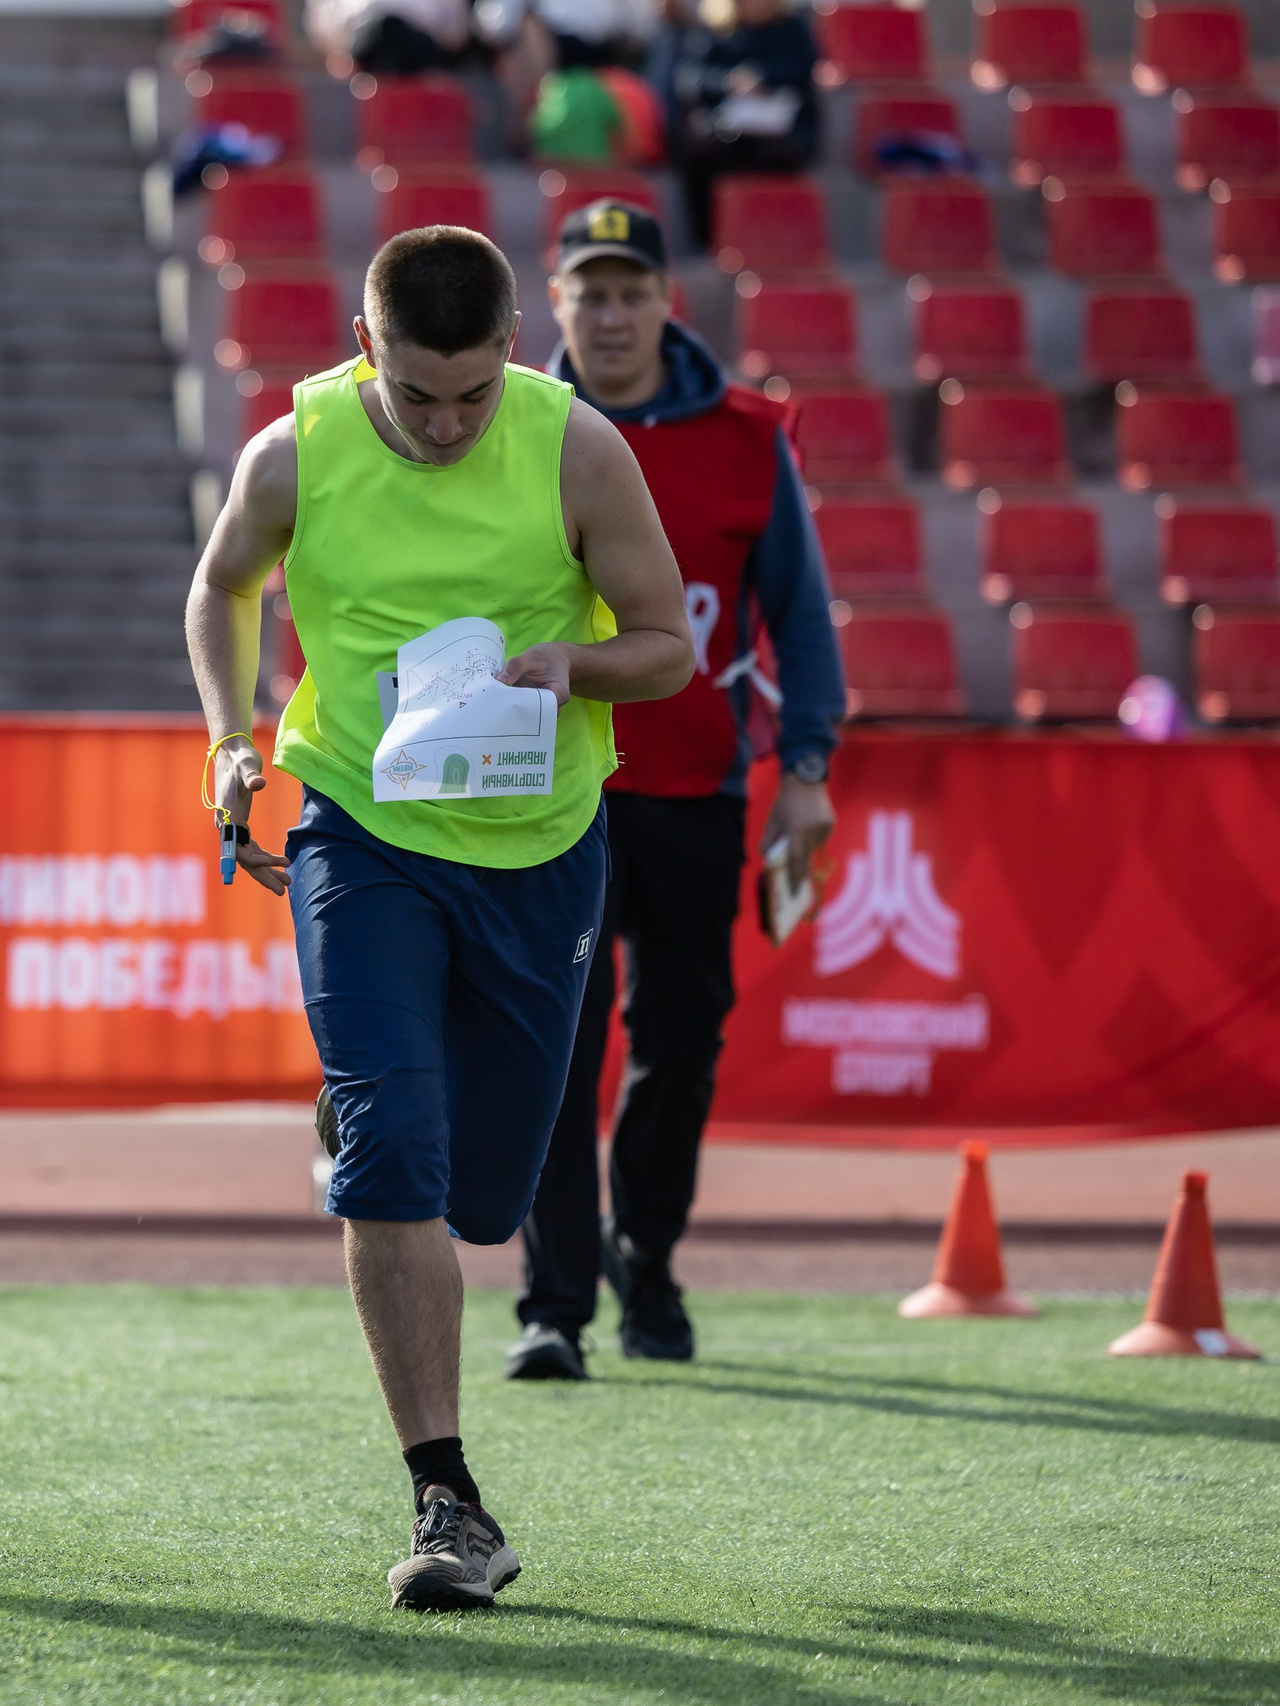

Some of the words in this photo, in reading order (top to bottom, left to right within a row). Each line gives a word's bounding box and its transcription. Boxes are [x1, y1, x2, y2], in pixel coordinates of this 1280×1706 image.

[496, 751, 548, 766] ЛАБИРИНТ
[481, 772, 546, 791] СПОРТИВНЫЙ
[832, 1050, 933, 1096] СПОРТ
